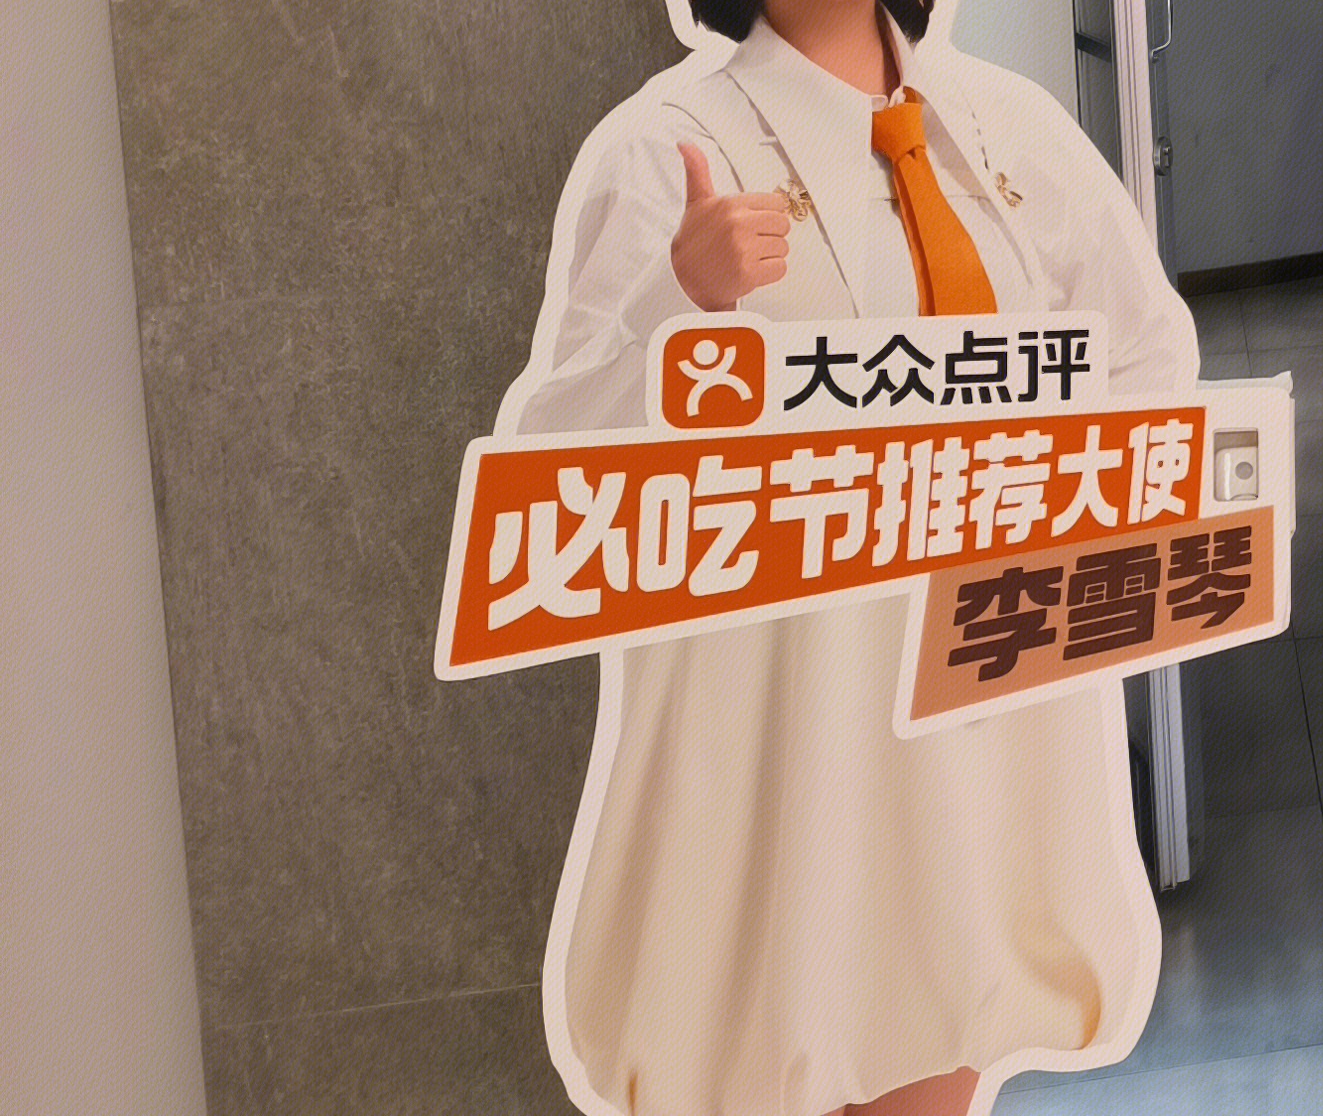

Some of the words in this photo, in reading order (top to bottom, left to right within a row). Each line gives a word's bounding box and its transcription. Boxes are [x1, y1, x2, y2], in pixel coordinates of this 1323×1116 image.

[783, 329, 1090, 411] 大众点评
[488, 418, 1192, 631] 必吃节推荐大使
[947, 526, 1252, 682] 李雪琴
